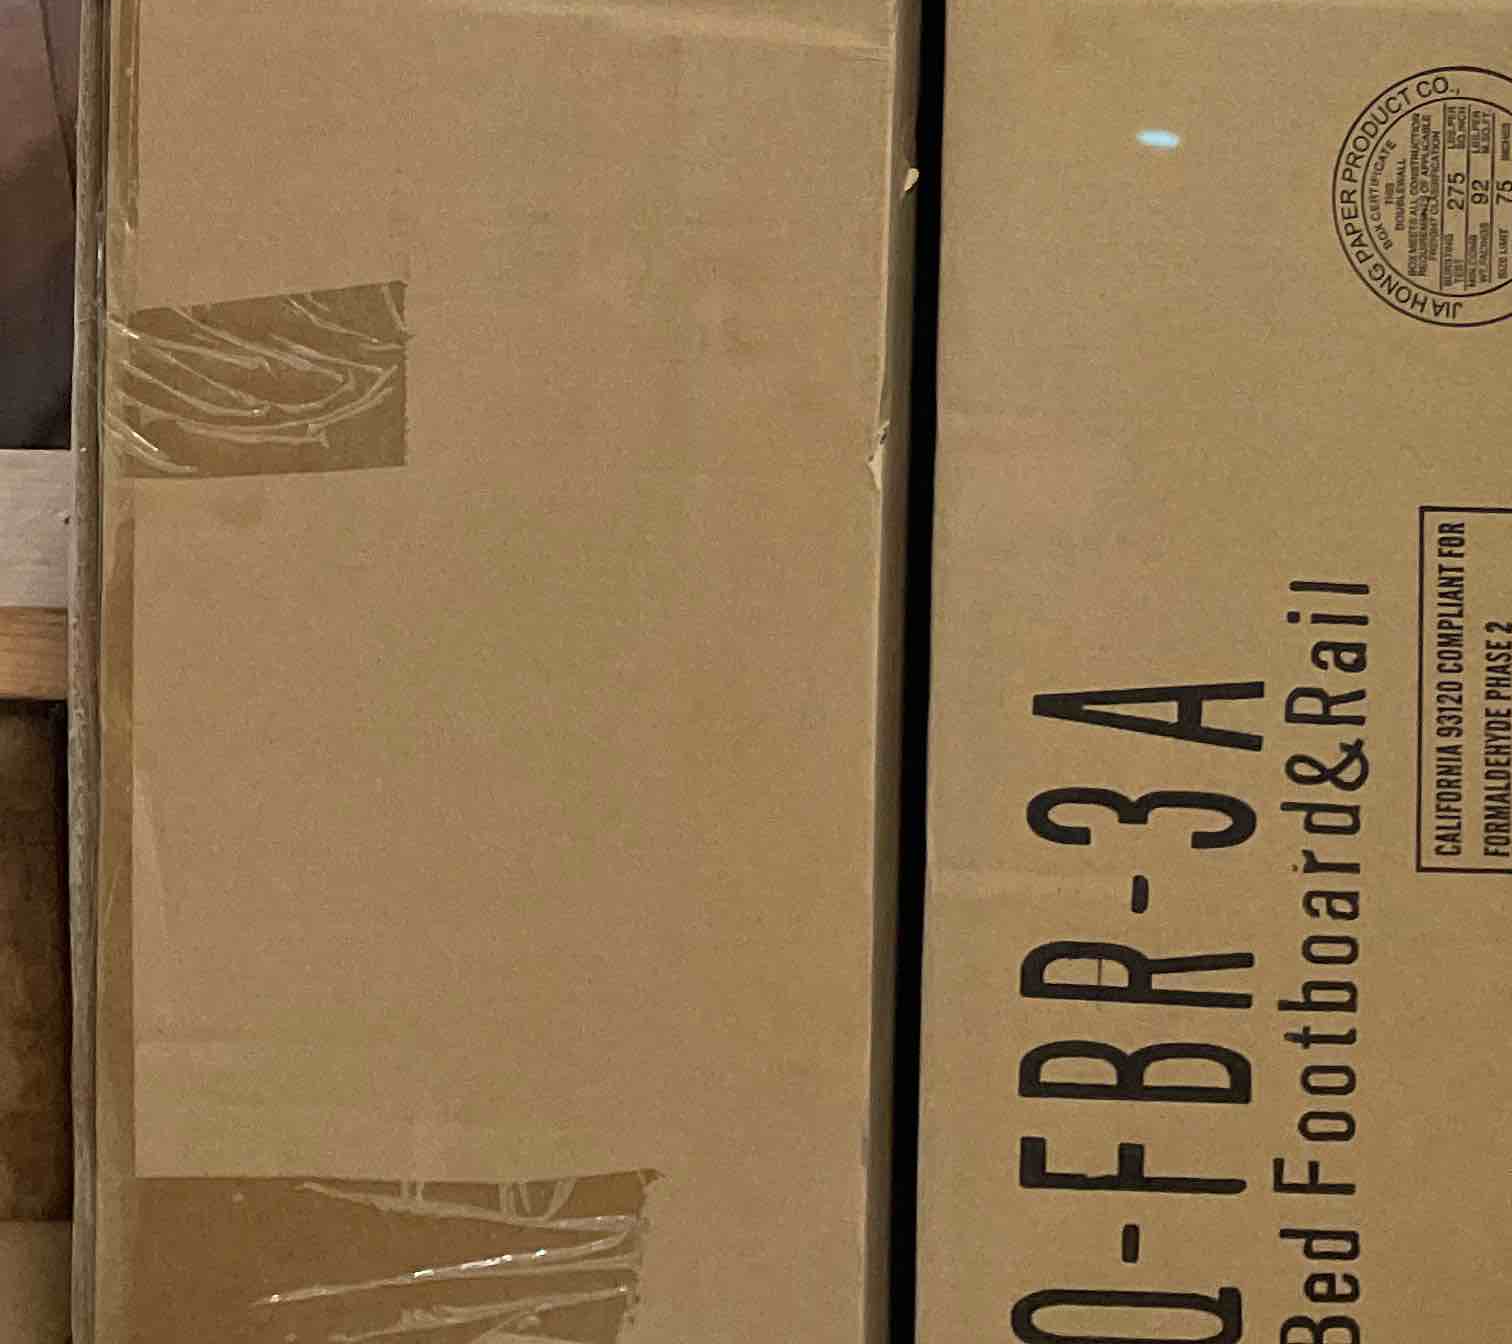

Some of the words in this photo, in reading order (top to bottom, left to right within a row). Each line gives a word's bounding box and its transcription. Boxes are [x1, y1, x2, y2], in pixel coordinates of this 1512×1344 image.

[1341, 87, 1410, 183] PRODUCT
[1367, 139, 1397, 222] CERTIFICATE
[1447, 172, 1465, 211] 275
[1472, 179, 1489, 205] 92
[1340, 190, 1374, 264] PAPER
[1375, 223, 1394, 250] BOX
[1437, 520, 1467, 558] FOR
[1436, 561, 1466, 675] COMPLIANT
[1434, 680, 1466, 739] 93120
[1433, 743, 1464, 857] CALIFORNIA
[1272, 578, 1371, 1196] Footboard&Rail
[1277, 1228, 1361, 1344] Bed
